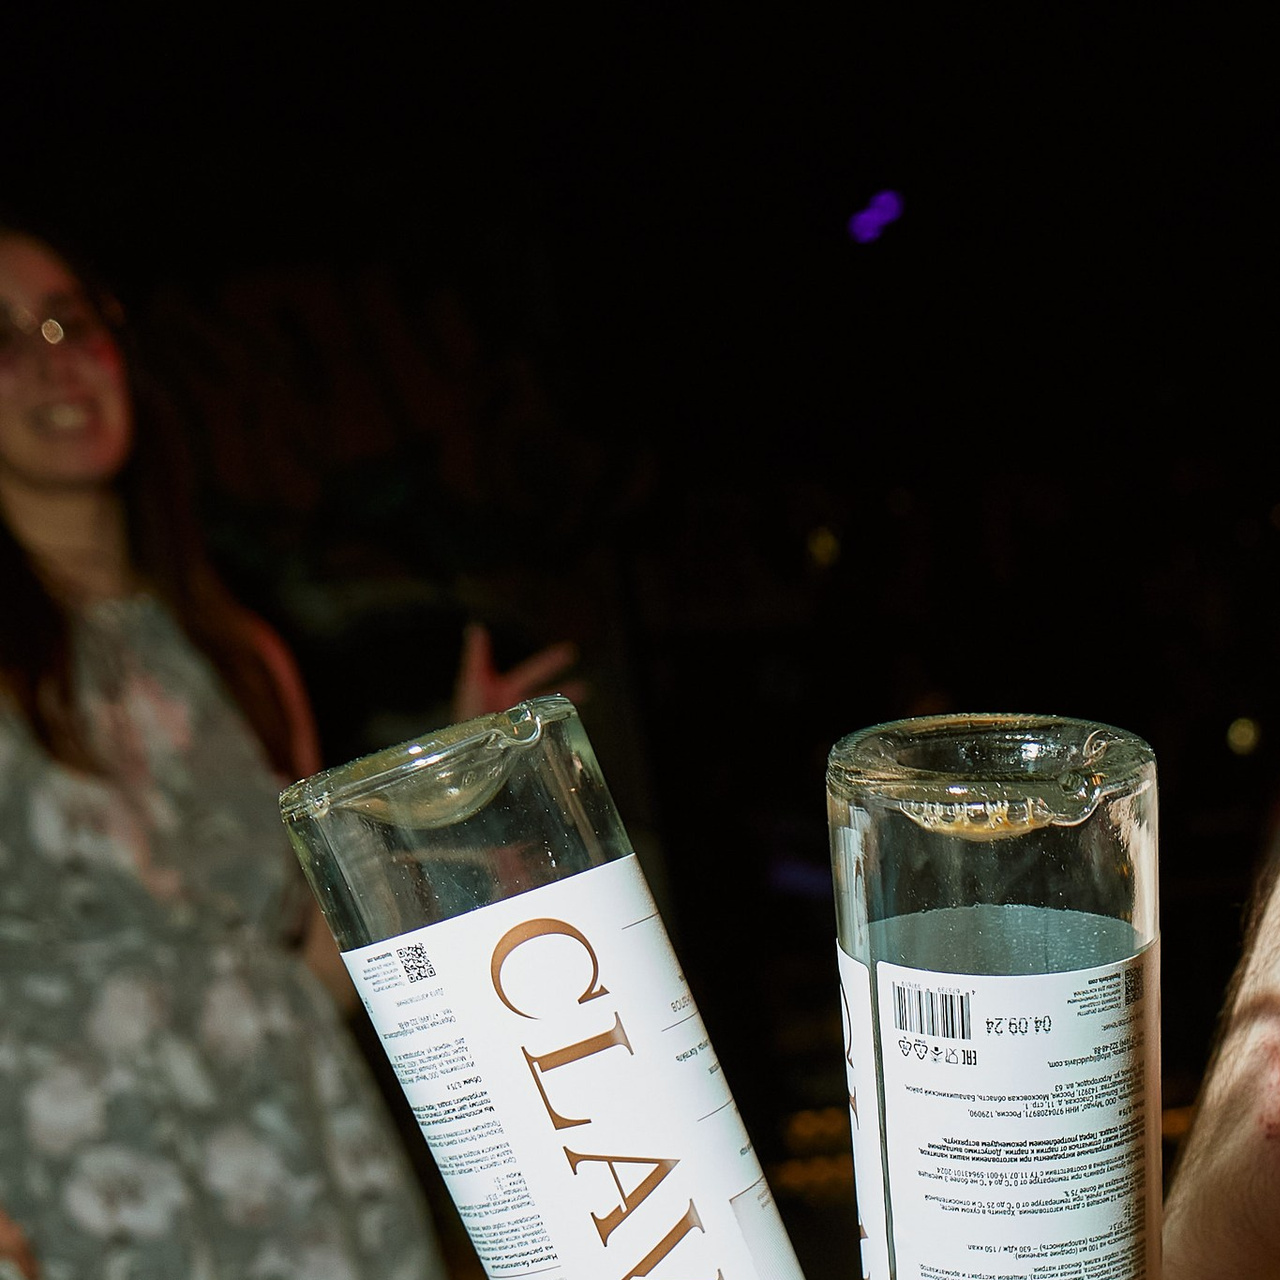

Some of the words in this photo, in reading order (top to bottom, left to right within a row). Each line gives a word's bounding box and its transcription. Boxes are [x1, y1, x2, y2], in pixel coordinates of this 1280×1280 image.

[985, 1015, 1052, 1036] 04.09.24
[1054, 1083, 1063, 1092] 63
[976, 1094, 1006, 1103] область,
[1007, 1093, 1049, 1102] Московская
[967, 1109, 994, 1118] 129090,
[1022, 1107, 1064, 1117] 9704208971,
[1065, 1105, 1079, 1114] ИНН
[995, 1110, 1021, 1119] Россия,
[1028, 1134, 1078, 1147] употреблением
[1079, 1131, 1098, 1142] Перед
[941, 1137, 980, 1146] встряхнуть.
[981, 1140, 1027, 1148] рекомендуем
[963, 1148, 1001, 1157] Допустимо
[1033, 1150, 1075, 1162] ингредиенты
[971, 1155, 1018, 1163] изготовлении
[1029, 1171, 1038, 1179] ТУ
[1030, 1197, 1071, 1209] температуре
[987, 1208, 1015, 1217] Хранить
[1017, 1205, 1064, 1216] изготовления.
[984, 1245, 997, 1253] 150
[1002, 1245, 1018, 1253] кДж
[1019, 1245, 1031, 1253] 630
[1088, 1243, 1099, 1252] 100
